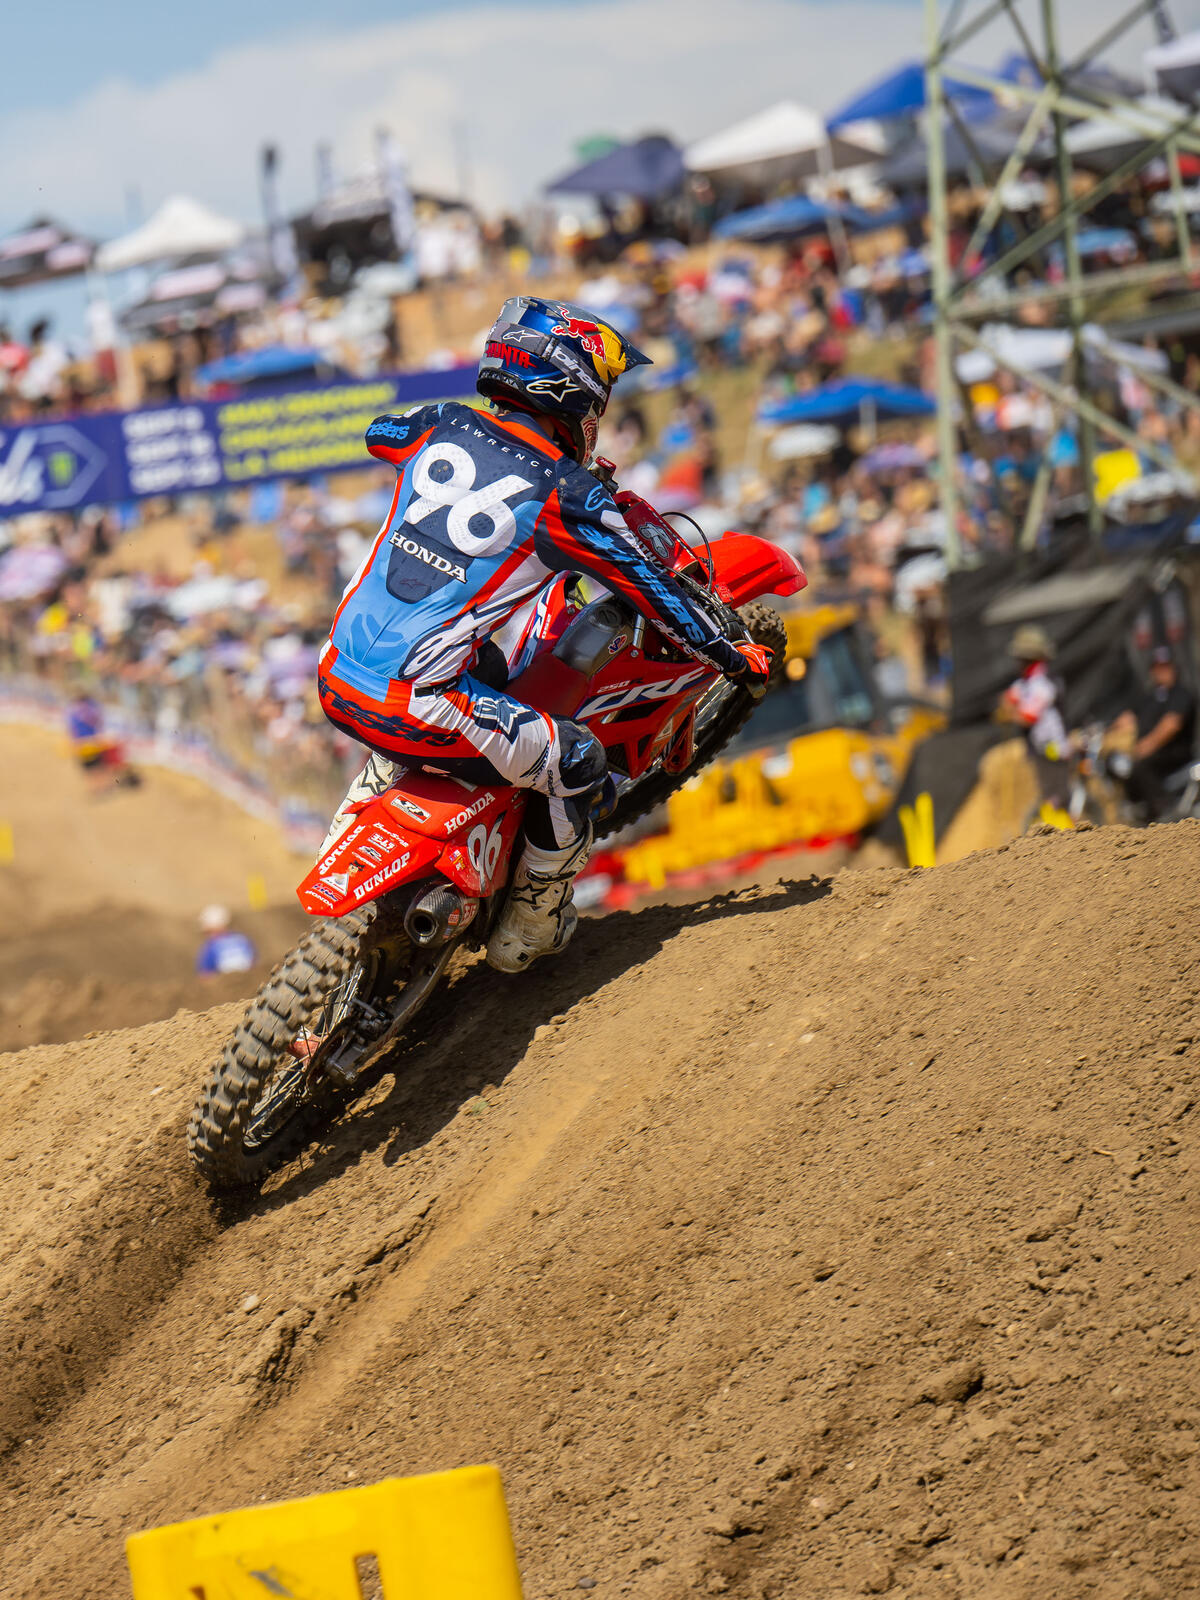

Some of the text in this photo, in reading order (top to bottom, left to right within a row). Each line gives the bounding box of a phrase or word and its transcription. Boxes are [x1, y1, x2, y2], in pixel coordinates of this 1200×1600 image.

[450, 417, 552, 478] LAWRENCE
[403, 441, 535, 558] 96
[389, 530, 468, 584] HONDA
[575, 665, 706, 720] CRF
[446, 791, 496, 835] HONDA
[353, 851, 411, 900] DUNLOP
[466, 811, 508, 895] 96
[305, 889, 334, 910] HONDA
